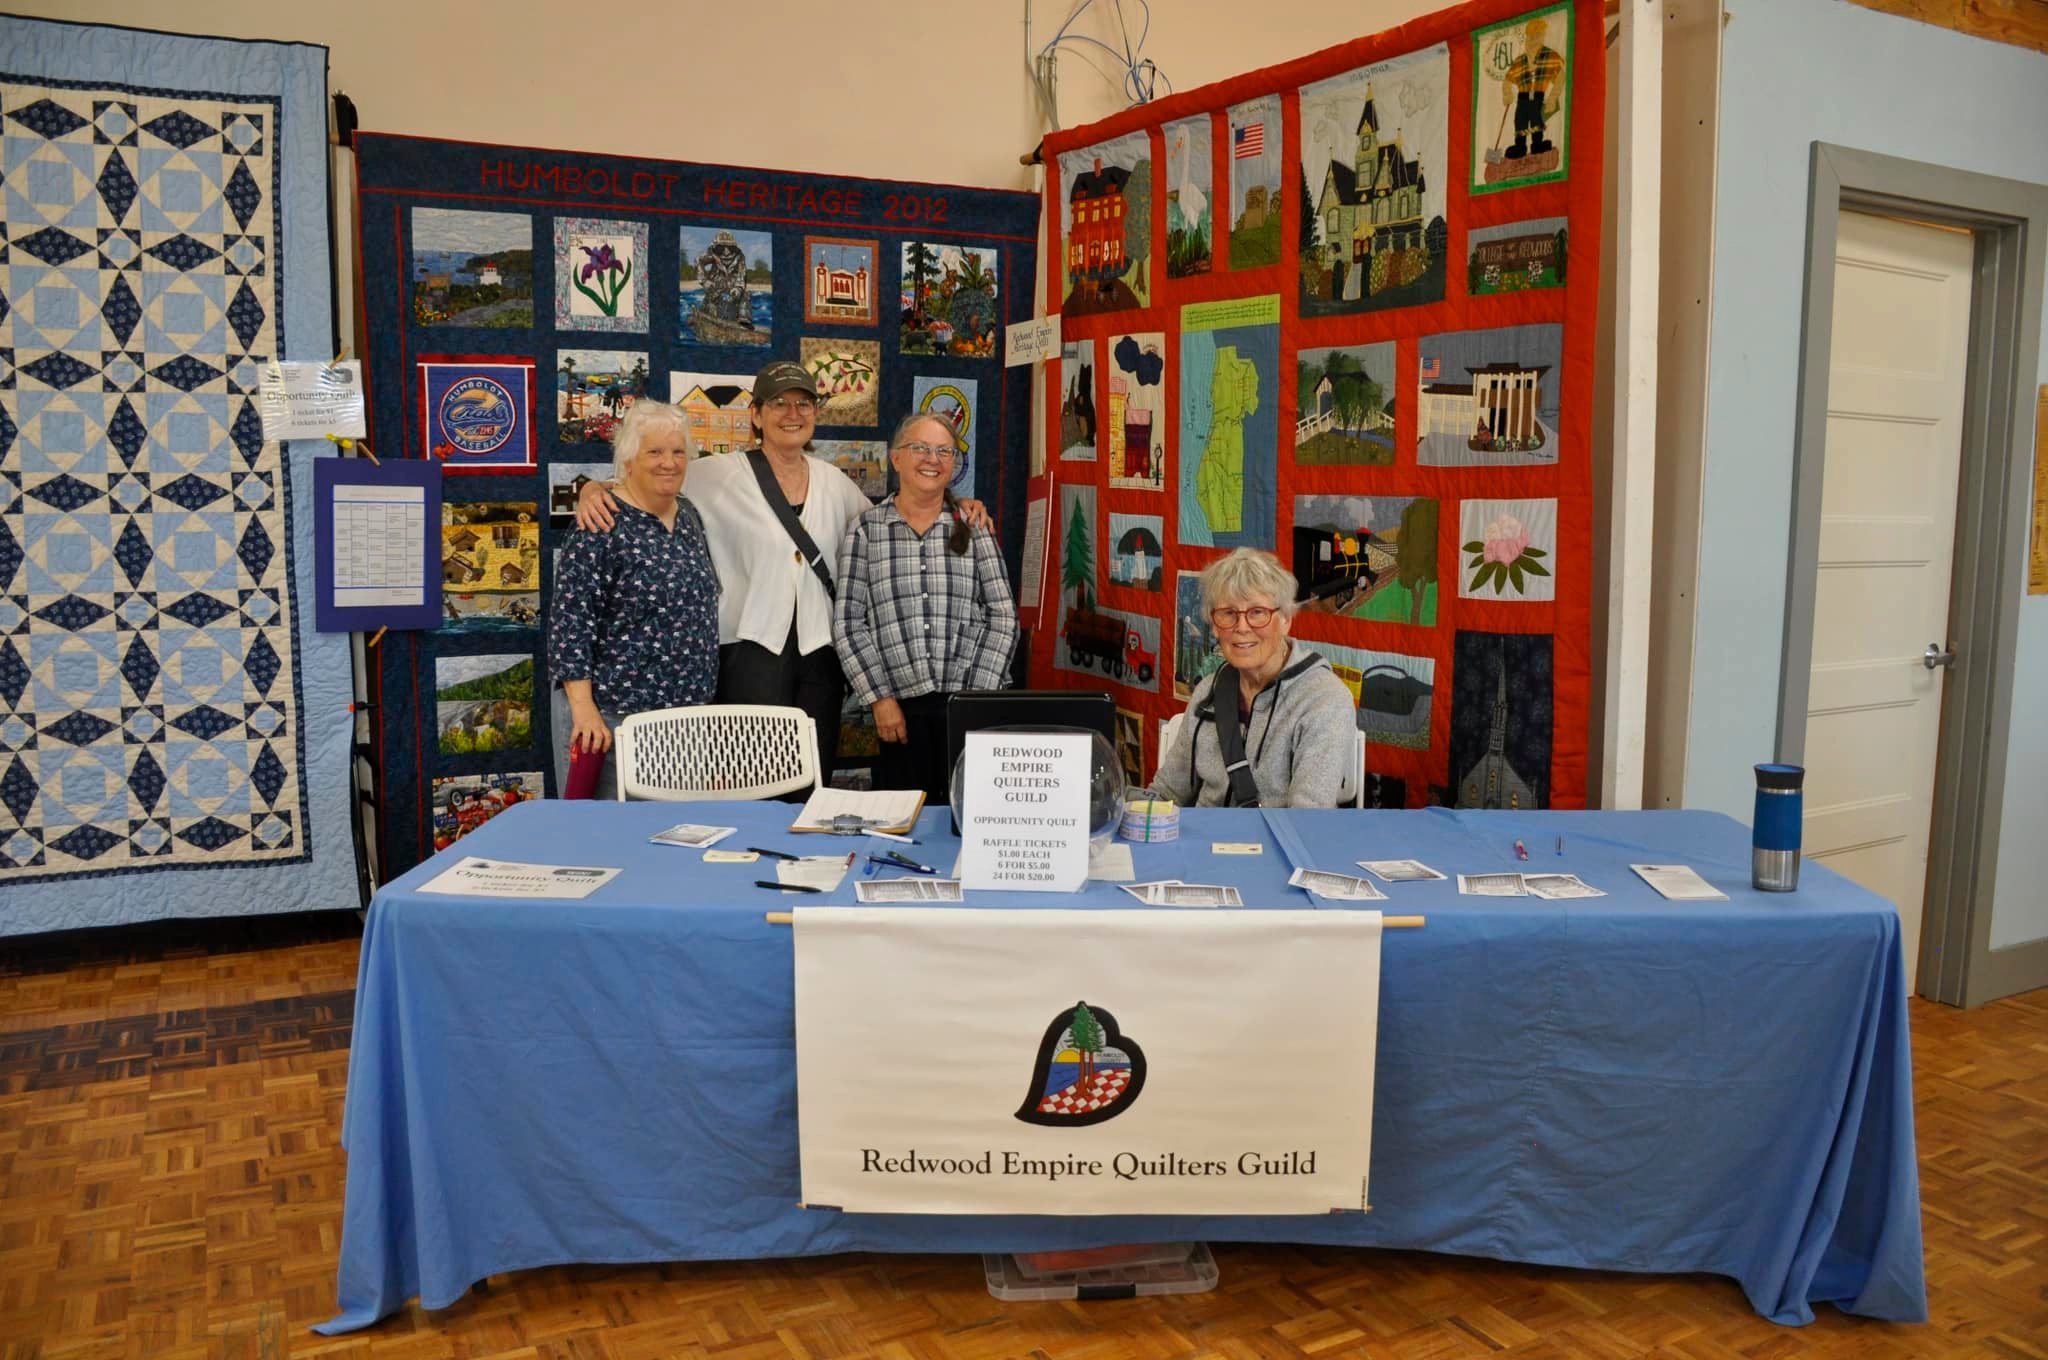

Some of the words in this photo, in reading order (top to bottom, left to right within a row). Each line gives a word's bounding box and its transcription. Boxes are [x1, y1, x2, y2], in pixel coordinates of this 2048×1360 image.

[481, 158, 681, 200] HUMBOLDT
[703, 179, 865, 217] HERITAGE
[882, 194, 949, 223] 2012
[448, 381, 503, 402] HUMBOLDT
[454, 432, 506, 450] BASEBALL
[992, 747, 1063, 758] REDWOOD
[1001, 762, 1053, 773] EMPIRE
[993, 776, 1060, 788] QUILTERS
[1004, 792, 1048, 803] GUILD
[974, 816, 1045, 826] OPPORTUNITY
[1046, 817, 1077, 827] QUILT
[983, 838, 1022, 848] RAFFLE
[1024, 839, 1067, 848] TICKETS
[998, 850, 1020, 858] $1.00
[1022, 850, 1051, 859] EACH
[997, 861, 1003, 869] 6
[1005, 861, 1026, 870] FOR
[1028, 862, 1050, 870] $5.00
[992, 871, 1003, 880] 24
[1005, 872, 1026, 881] FOR
[1027, 872, 1055, 881] $20.00
[861, 1149, 992, 1174] Redwood
[1001, 1151, 1103, 1180] Empire
[1112, 1152, 1227, 1180] Quilters
[1237, 1150, 1317, 1175] Guild
